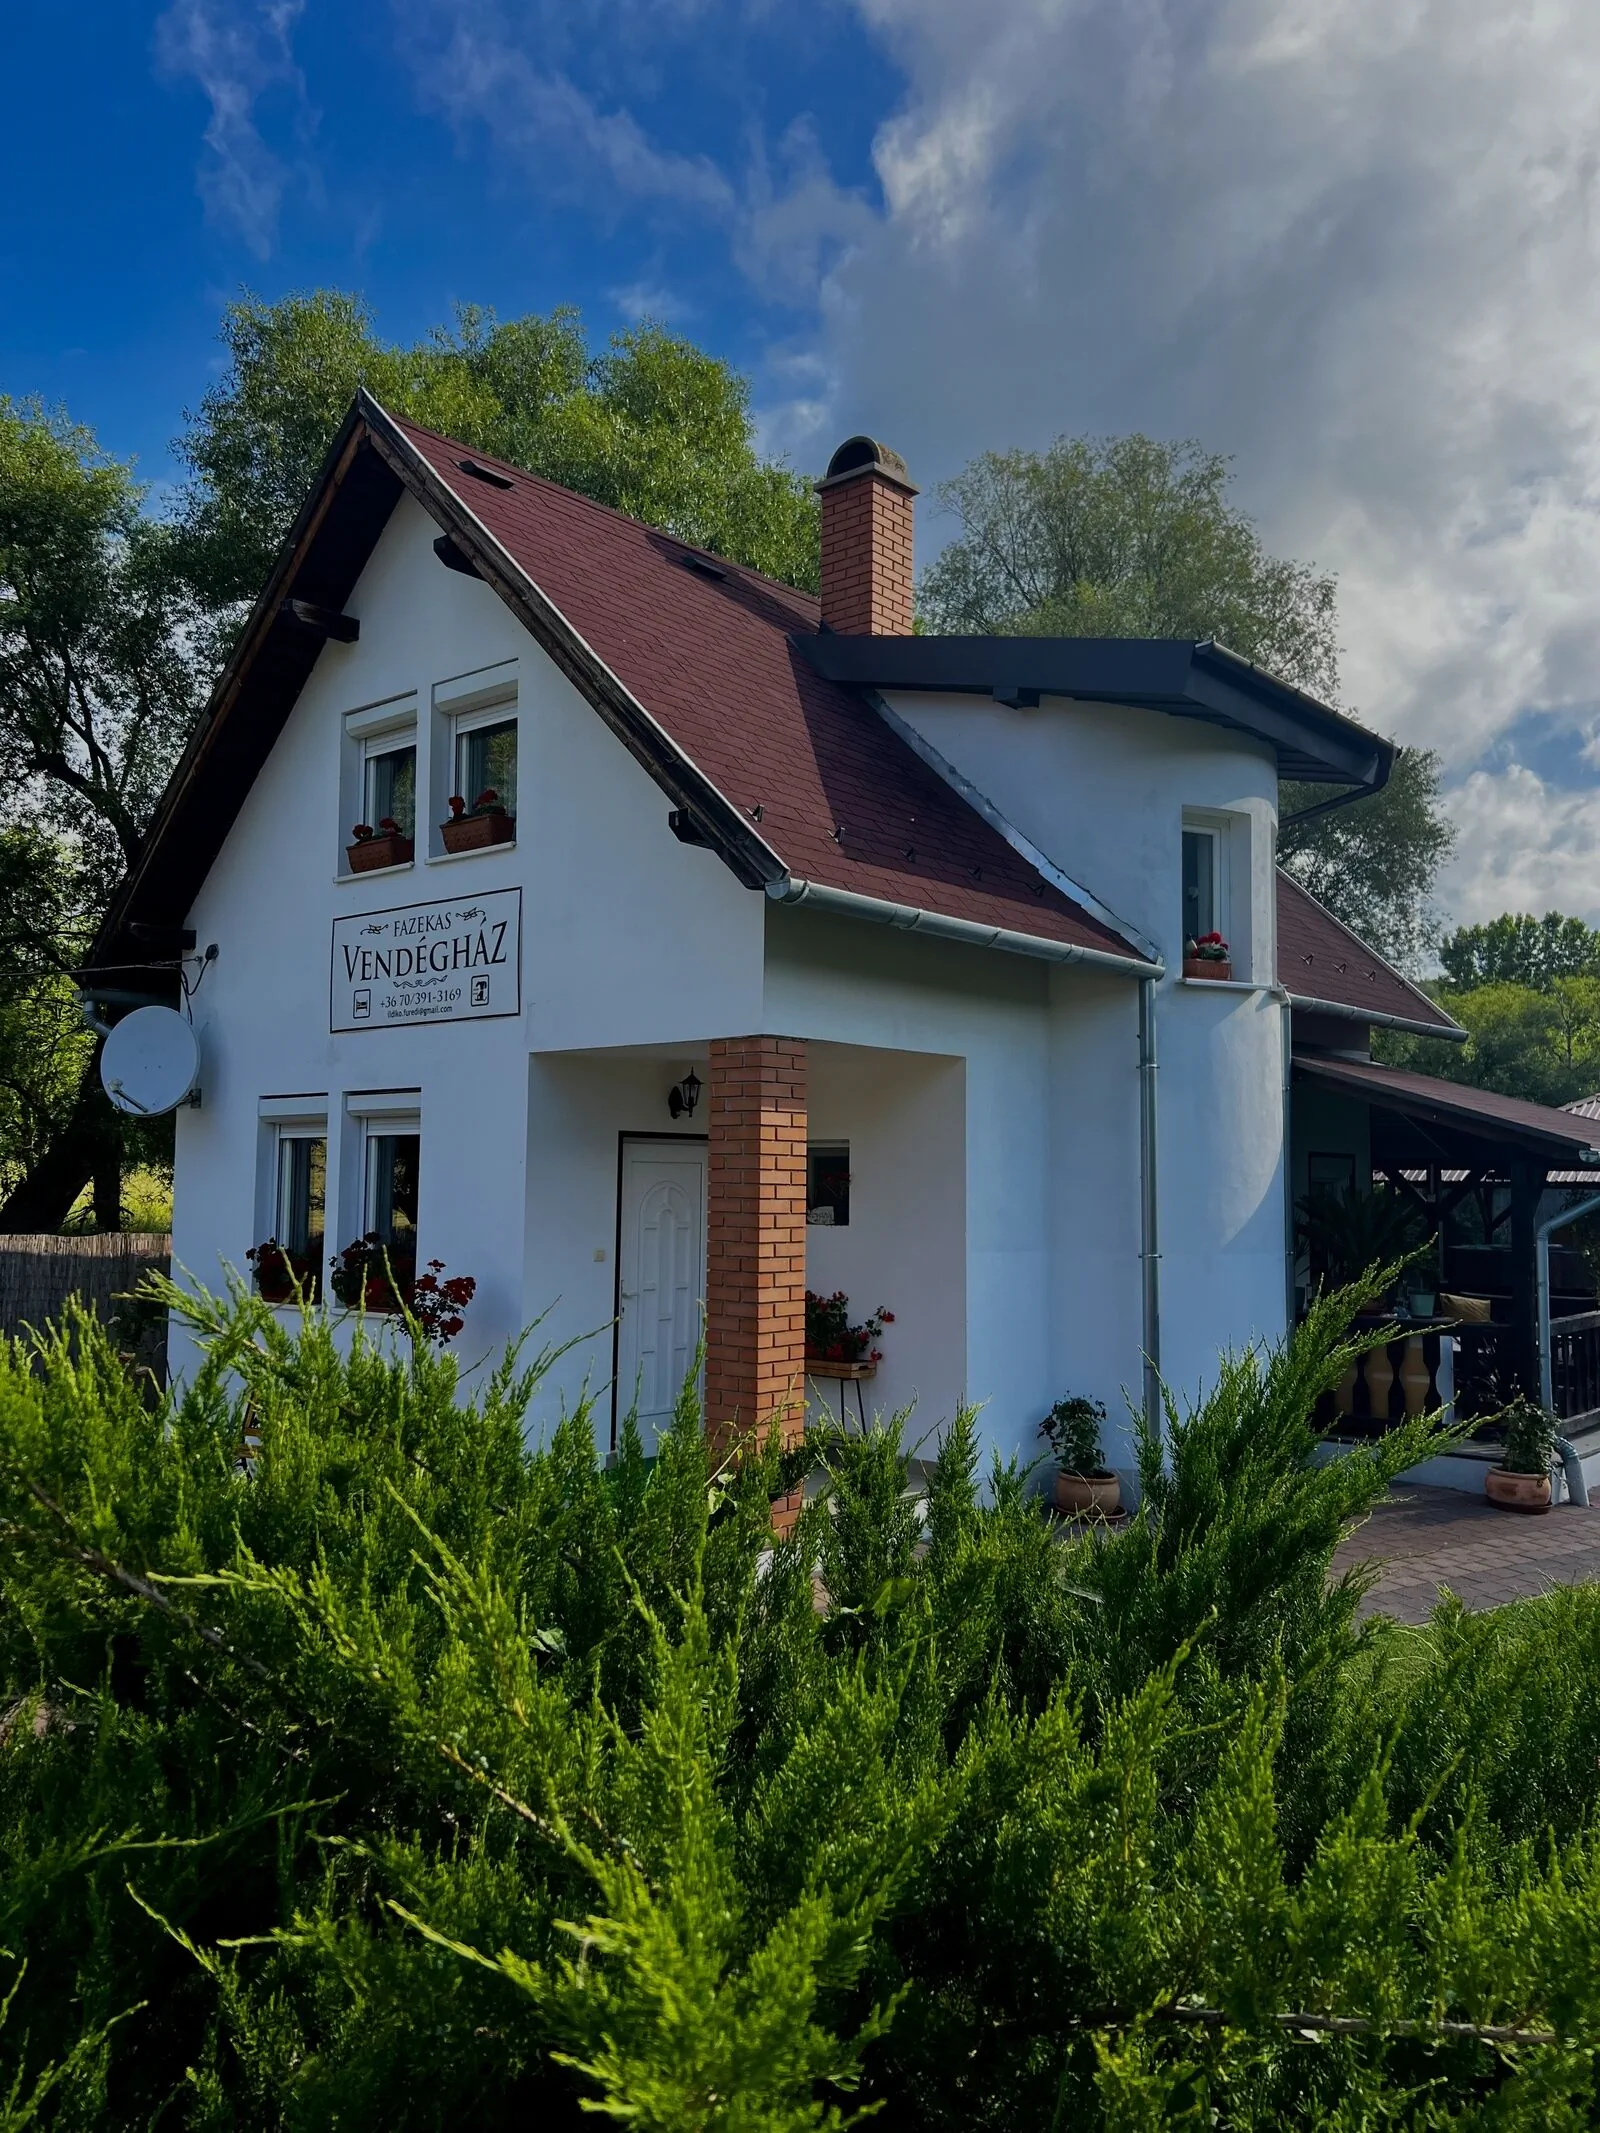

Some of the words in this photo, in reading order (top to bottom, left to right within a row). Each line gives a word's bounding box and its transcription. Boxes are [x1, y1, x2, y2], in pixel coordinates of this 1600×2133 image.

[394, 912, 452, 937] FAZEKAS
[342, 916, 508, 983] VENDÉGHÁZ
[379, 995, 397, 1009] +36
[399, 988, 462, 1007] 70/391-3169
